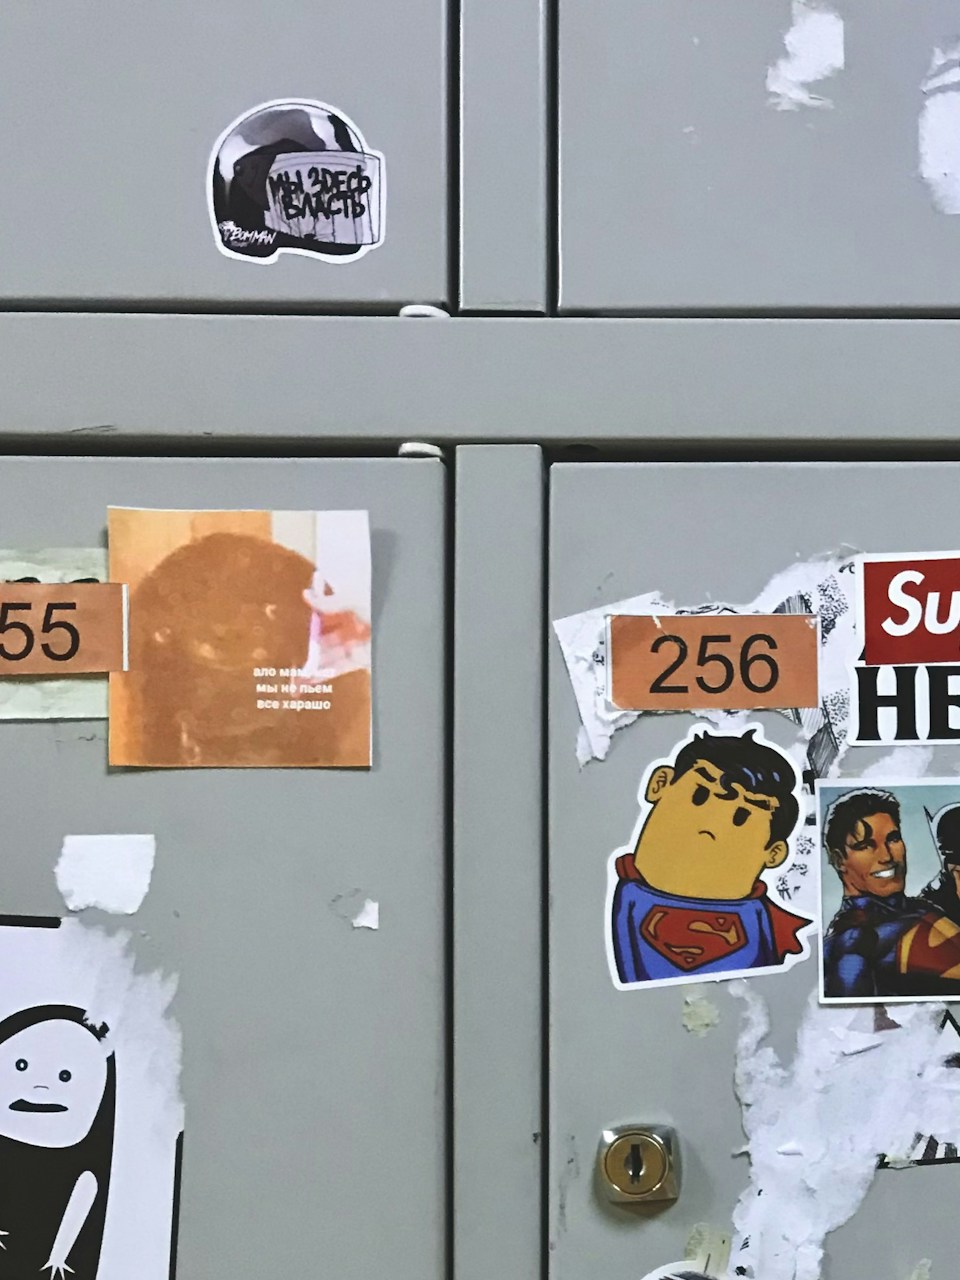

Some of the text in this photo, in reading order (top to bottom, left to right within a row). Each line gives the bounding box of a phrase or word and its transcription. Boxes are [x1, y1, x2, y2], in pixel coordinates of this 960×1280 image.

[281, 191, 366, 220] ВЛАСТЬ
[649, 634, 779, 694] 256
[256, 683, 279, 694] мы
[281, 683, 298, 694] не
[256, 699, 280, 710] все
